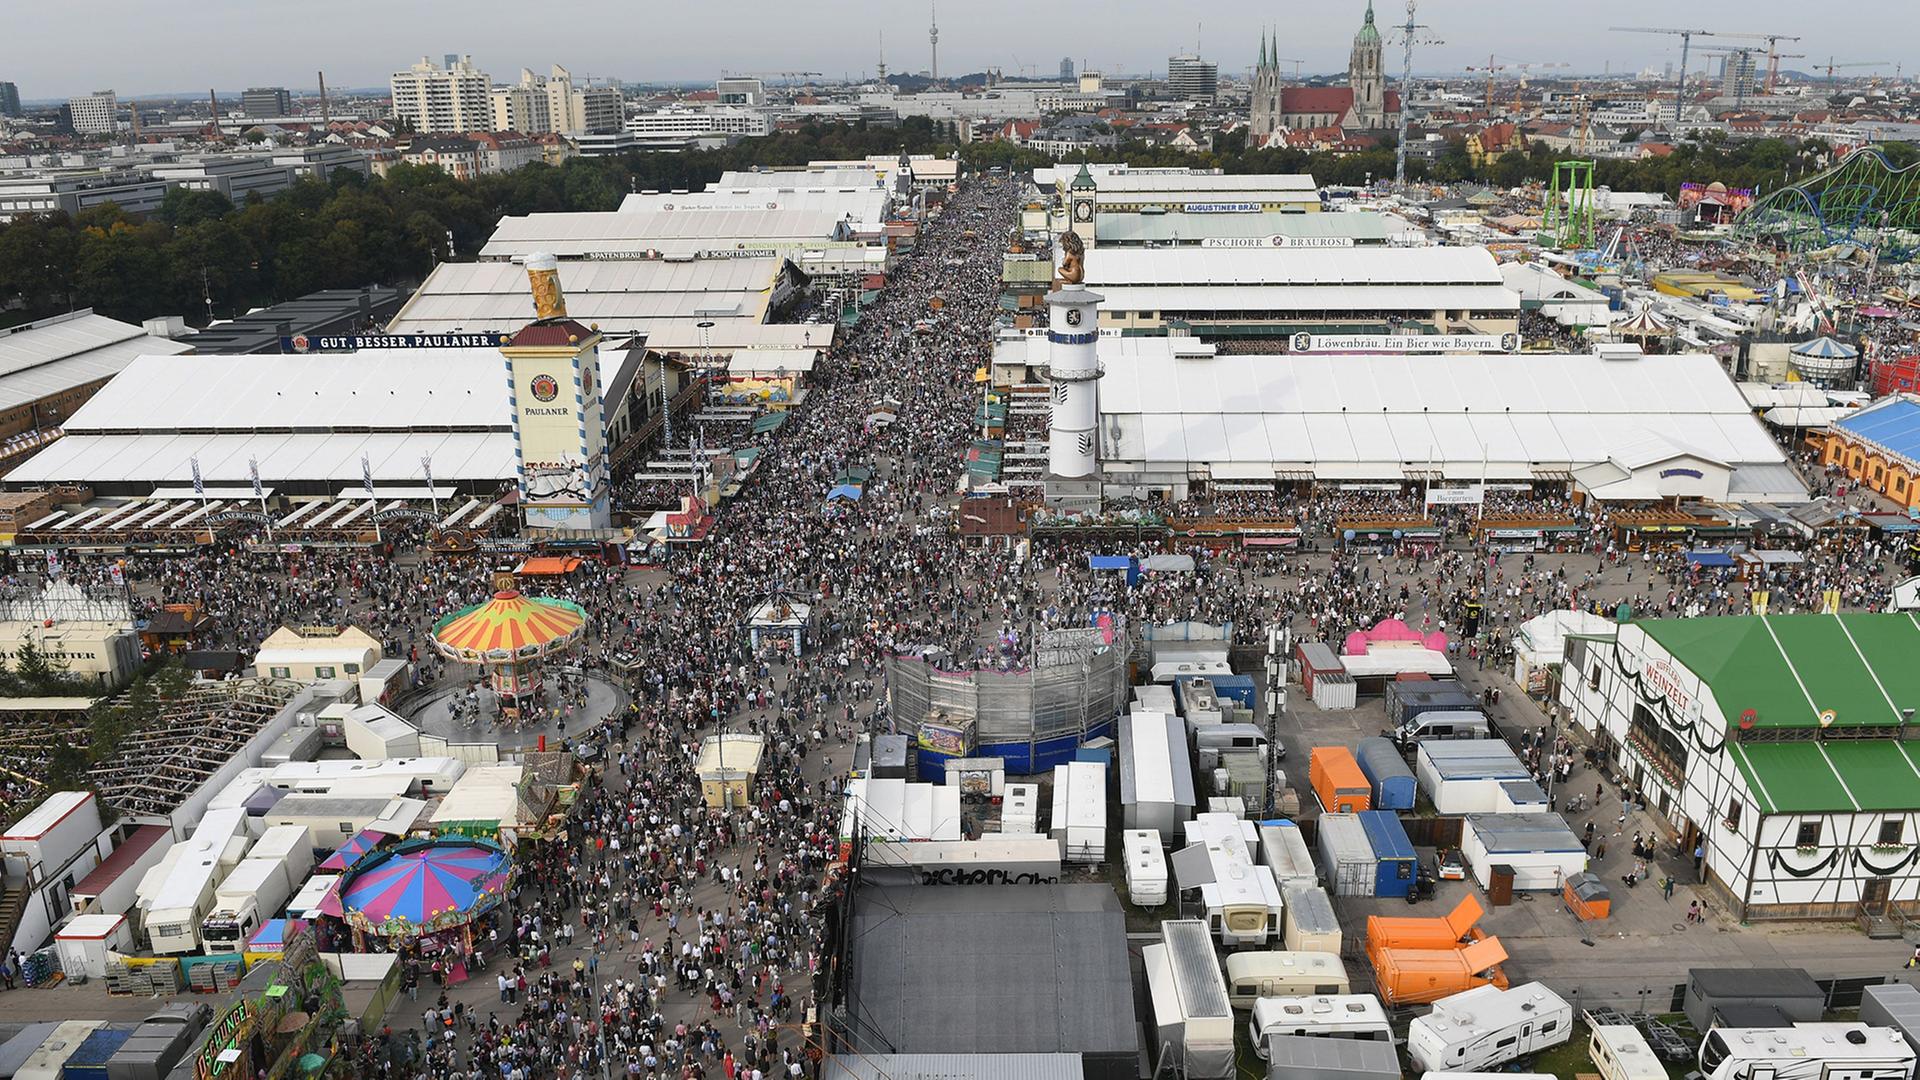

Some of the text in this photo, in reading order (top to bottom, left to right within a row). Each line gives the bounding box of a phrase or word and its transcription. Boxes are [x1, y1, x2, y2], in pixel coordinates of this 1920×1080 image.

[1210, 239, 1262, 247] PSCHORR
[320, 335, 495, 351] GUT, BESSER, PAULANER.
[1317, 337, 1495, 351] Löwenbräu. Ein Bier wie Bayern.
[525, 407, 568, 416] PAULANER
[1437, 494, 1474, 503] Biergarten
[204, 512, 272, 526] PAULANERGARTEN
[373, 510, 441, 523] PAULANERGARTEN
[1646, 662, 1689, 711] WEINZELT
[197, 999, 252, 1080] DSCHUNGEL
